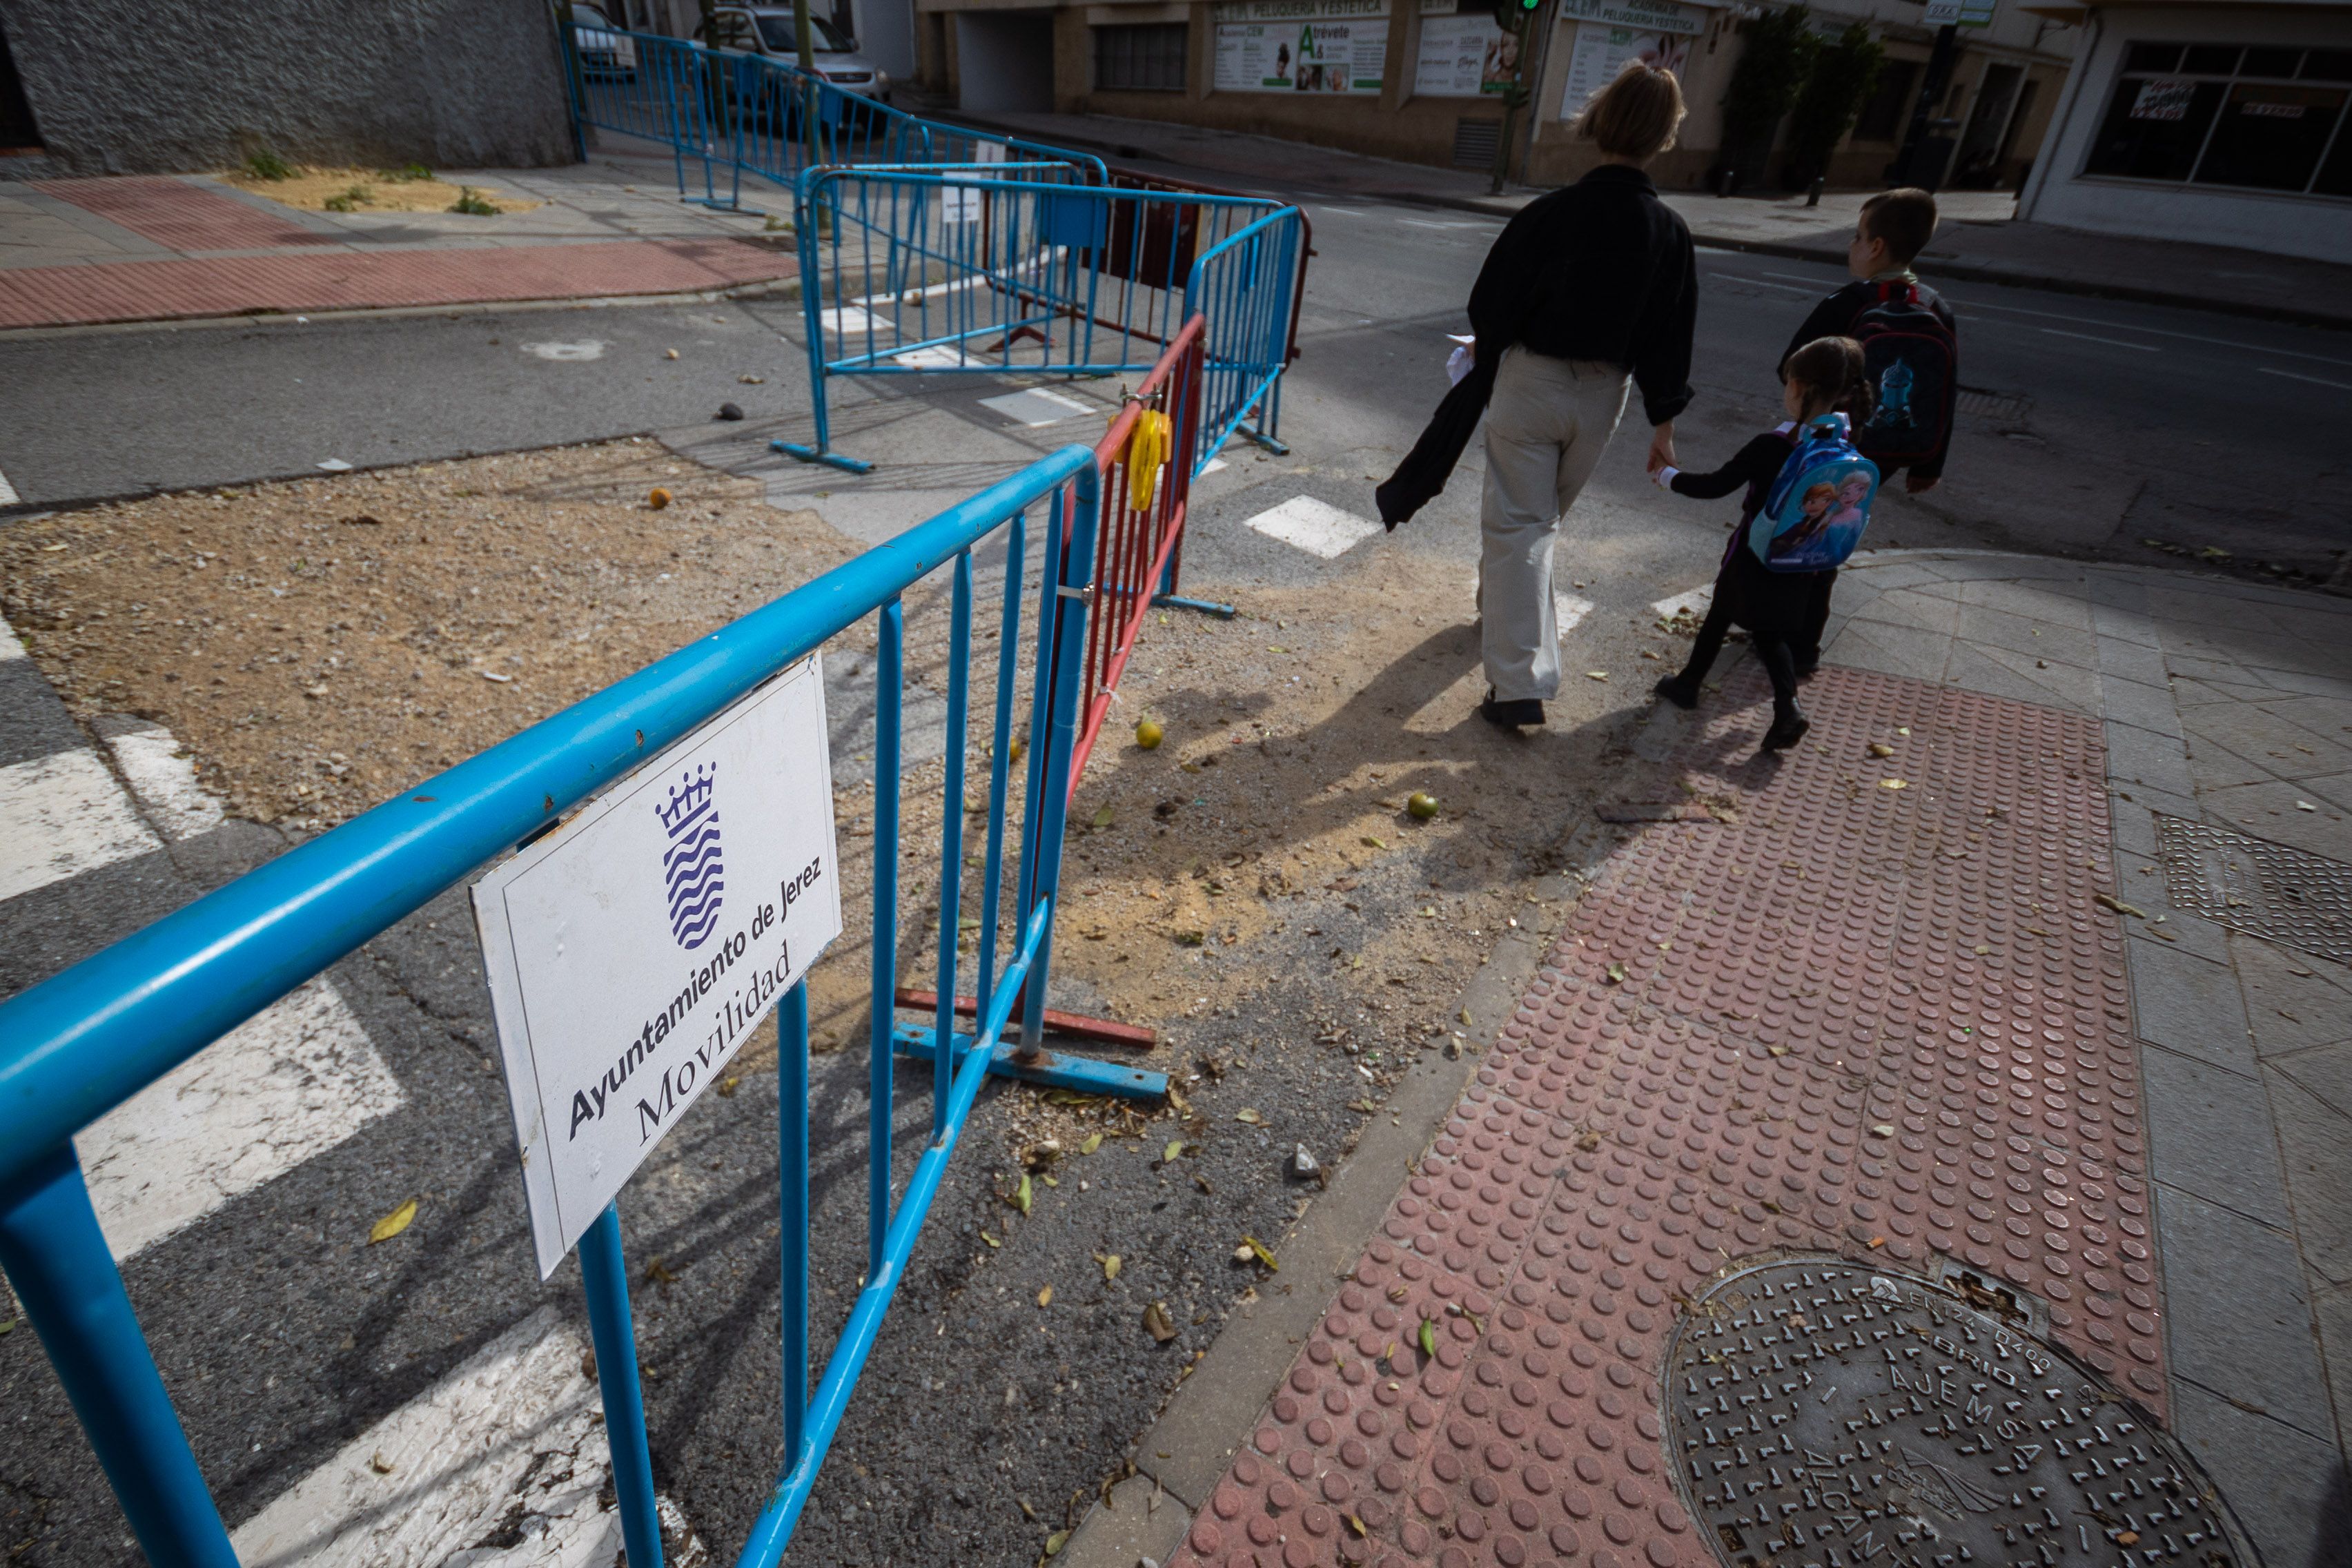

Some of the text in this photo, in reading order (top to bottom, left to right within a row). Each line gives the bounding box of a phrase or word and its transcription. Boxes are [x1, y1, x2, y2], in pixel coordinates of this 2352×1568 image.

[569, 856, 821, 1142] Ayuntamiento de Jerez
[634, 940, 790, 1147] Movilidad
[1909, 1291, 1936, 1311] EN
[1888, 1364, 2044, 1464] AJEMSA
